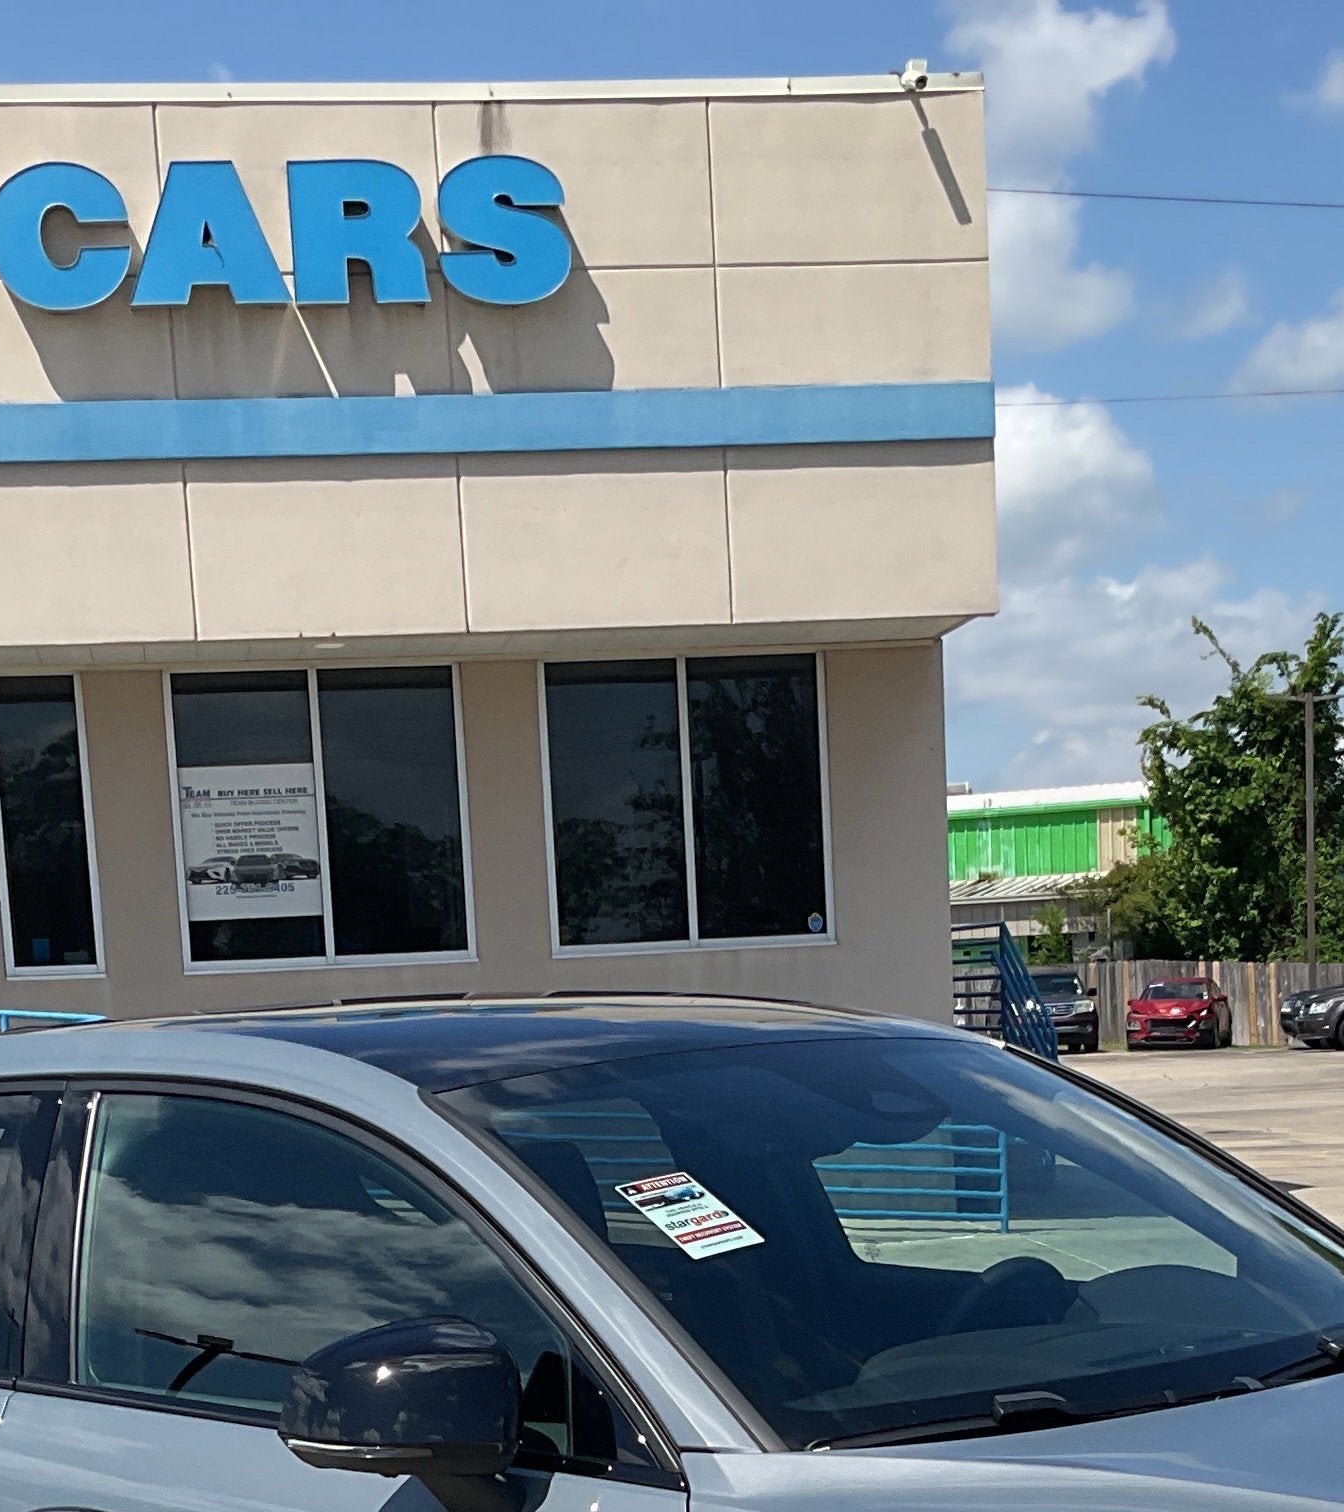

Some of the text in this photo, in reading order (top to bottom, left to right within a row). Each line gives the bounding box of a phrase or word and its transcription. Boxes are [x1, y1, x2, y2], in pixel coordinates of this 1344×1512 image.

[182, 786, 211, 799] TEAM
[237, 788, 260, 796] HERE
[263, 787, 282, 795] SELL
[284, 786, 308, 795] HERE
[640, 1175, 690, 1192] ATTENTION
[664, 1209, 723, 1232] stargard
